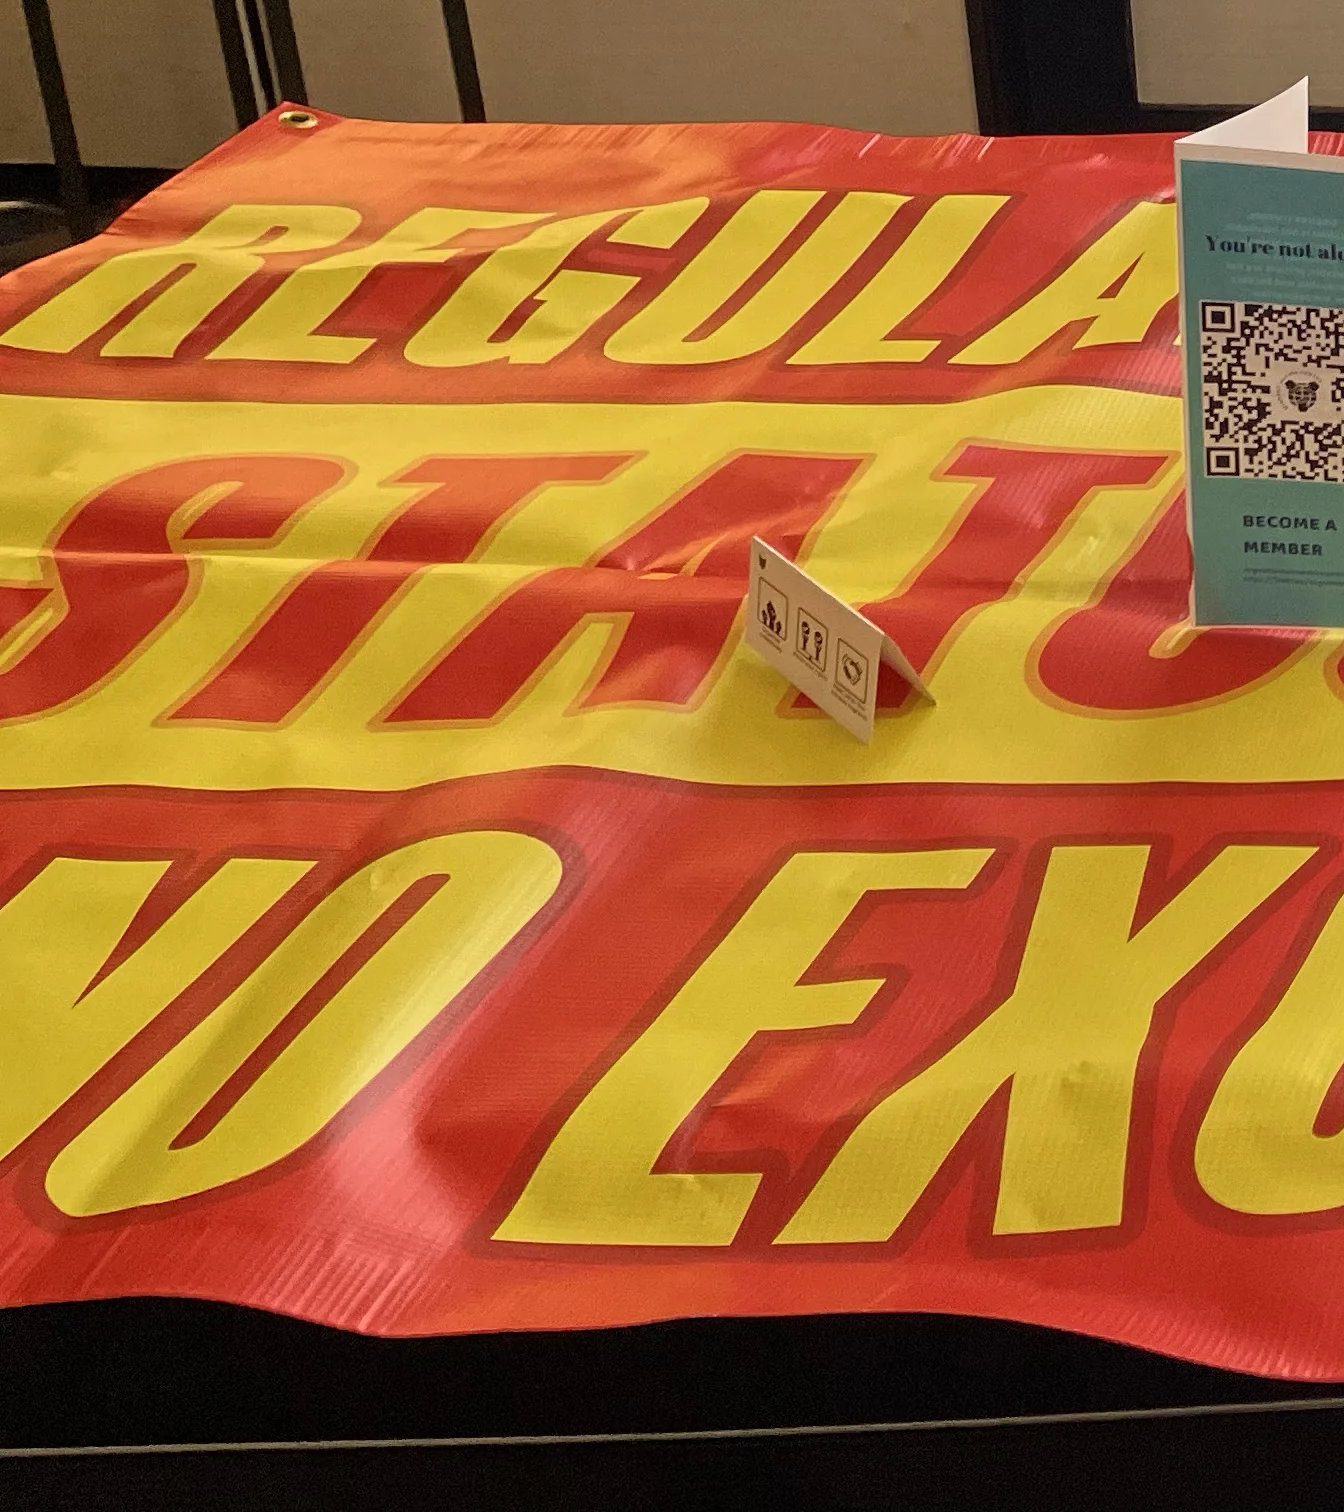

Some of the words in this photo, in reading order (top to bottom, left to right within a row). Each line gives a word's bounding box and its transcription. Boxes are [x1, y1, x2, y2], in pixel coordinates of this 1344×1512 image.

[1206, 235, 1274, 255] You're
[1279, 244, 1312, 259] not
[1243, 515, 1320, 530] BECOME
[1325, 520, 1337, 531] A
[1244, 542, 1322, 556] MEMBER
